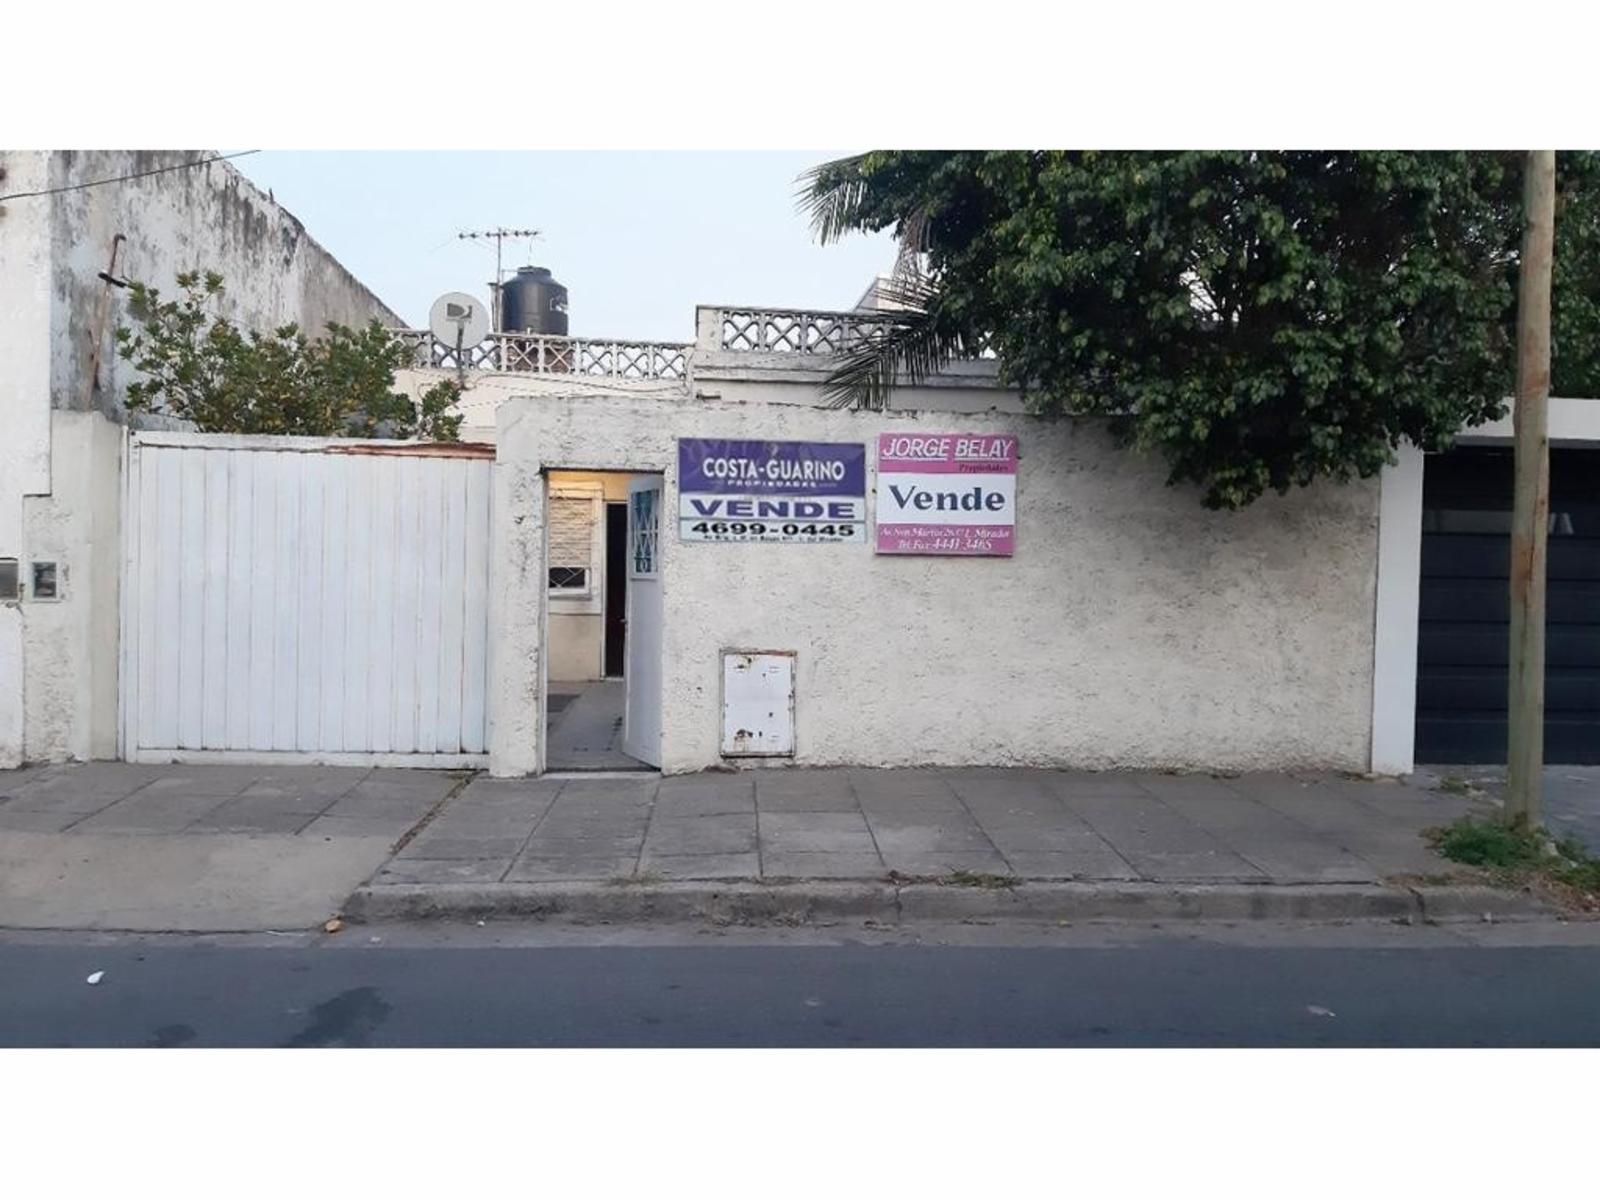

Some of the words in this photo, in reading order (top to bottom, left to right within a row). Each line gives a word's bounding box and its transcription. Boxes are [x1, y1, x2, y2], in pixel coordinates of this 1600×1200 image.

[883, 438, 951, 457] JORGE
[955, 439, 1012, 458] BELAY
[702, 458, 845, 481] COSTA-GUARINO
[727, 480, 817, 488] PROPIEDADES
[888, 485, 1005, 511] Vende
[690, 500, 855, 518] VENDE
[691, 522, 854, 537] 4699-0445
